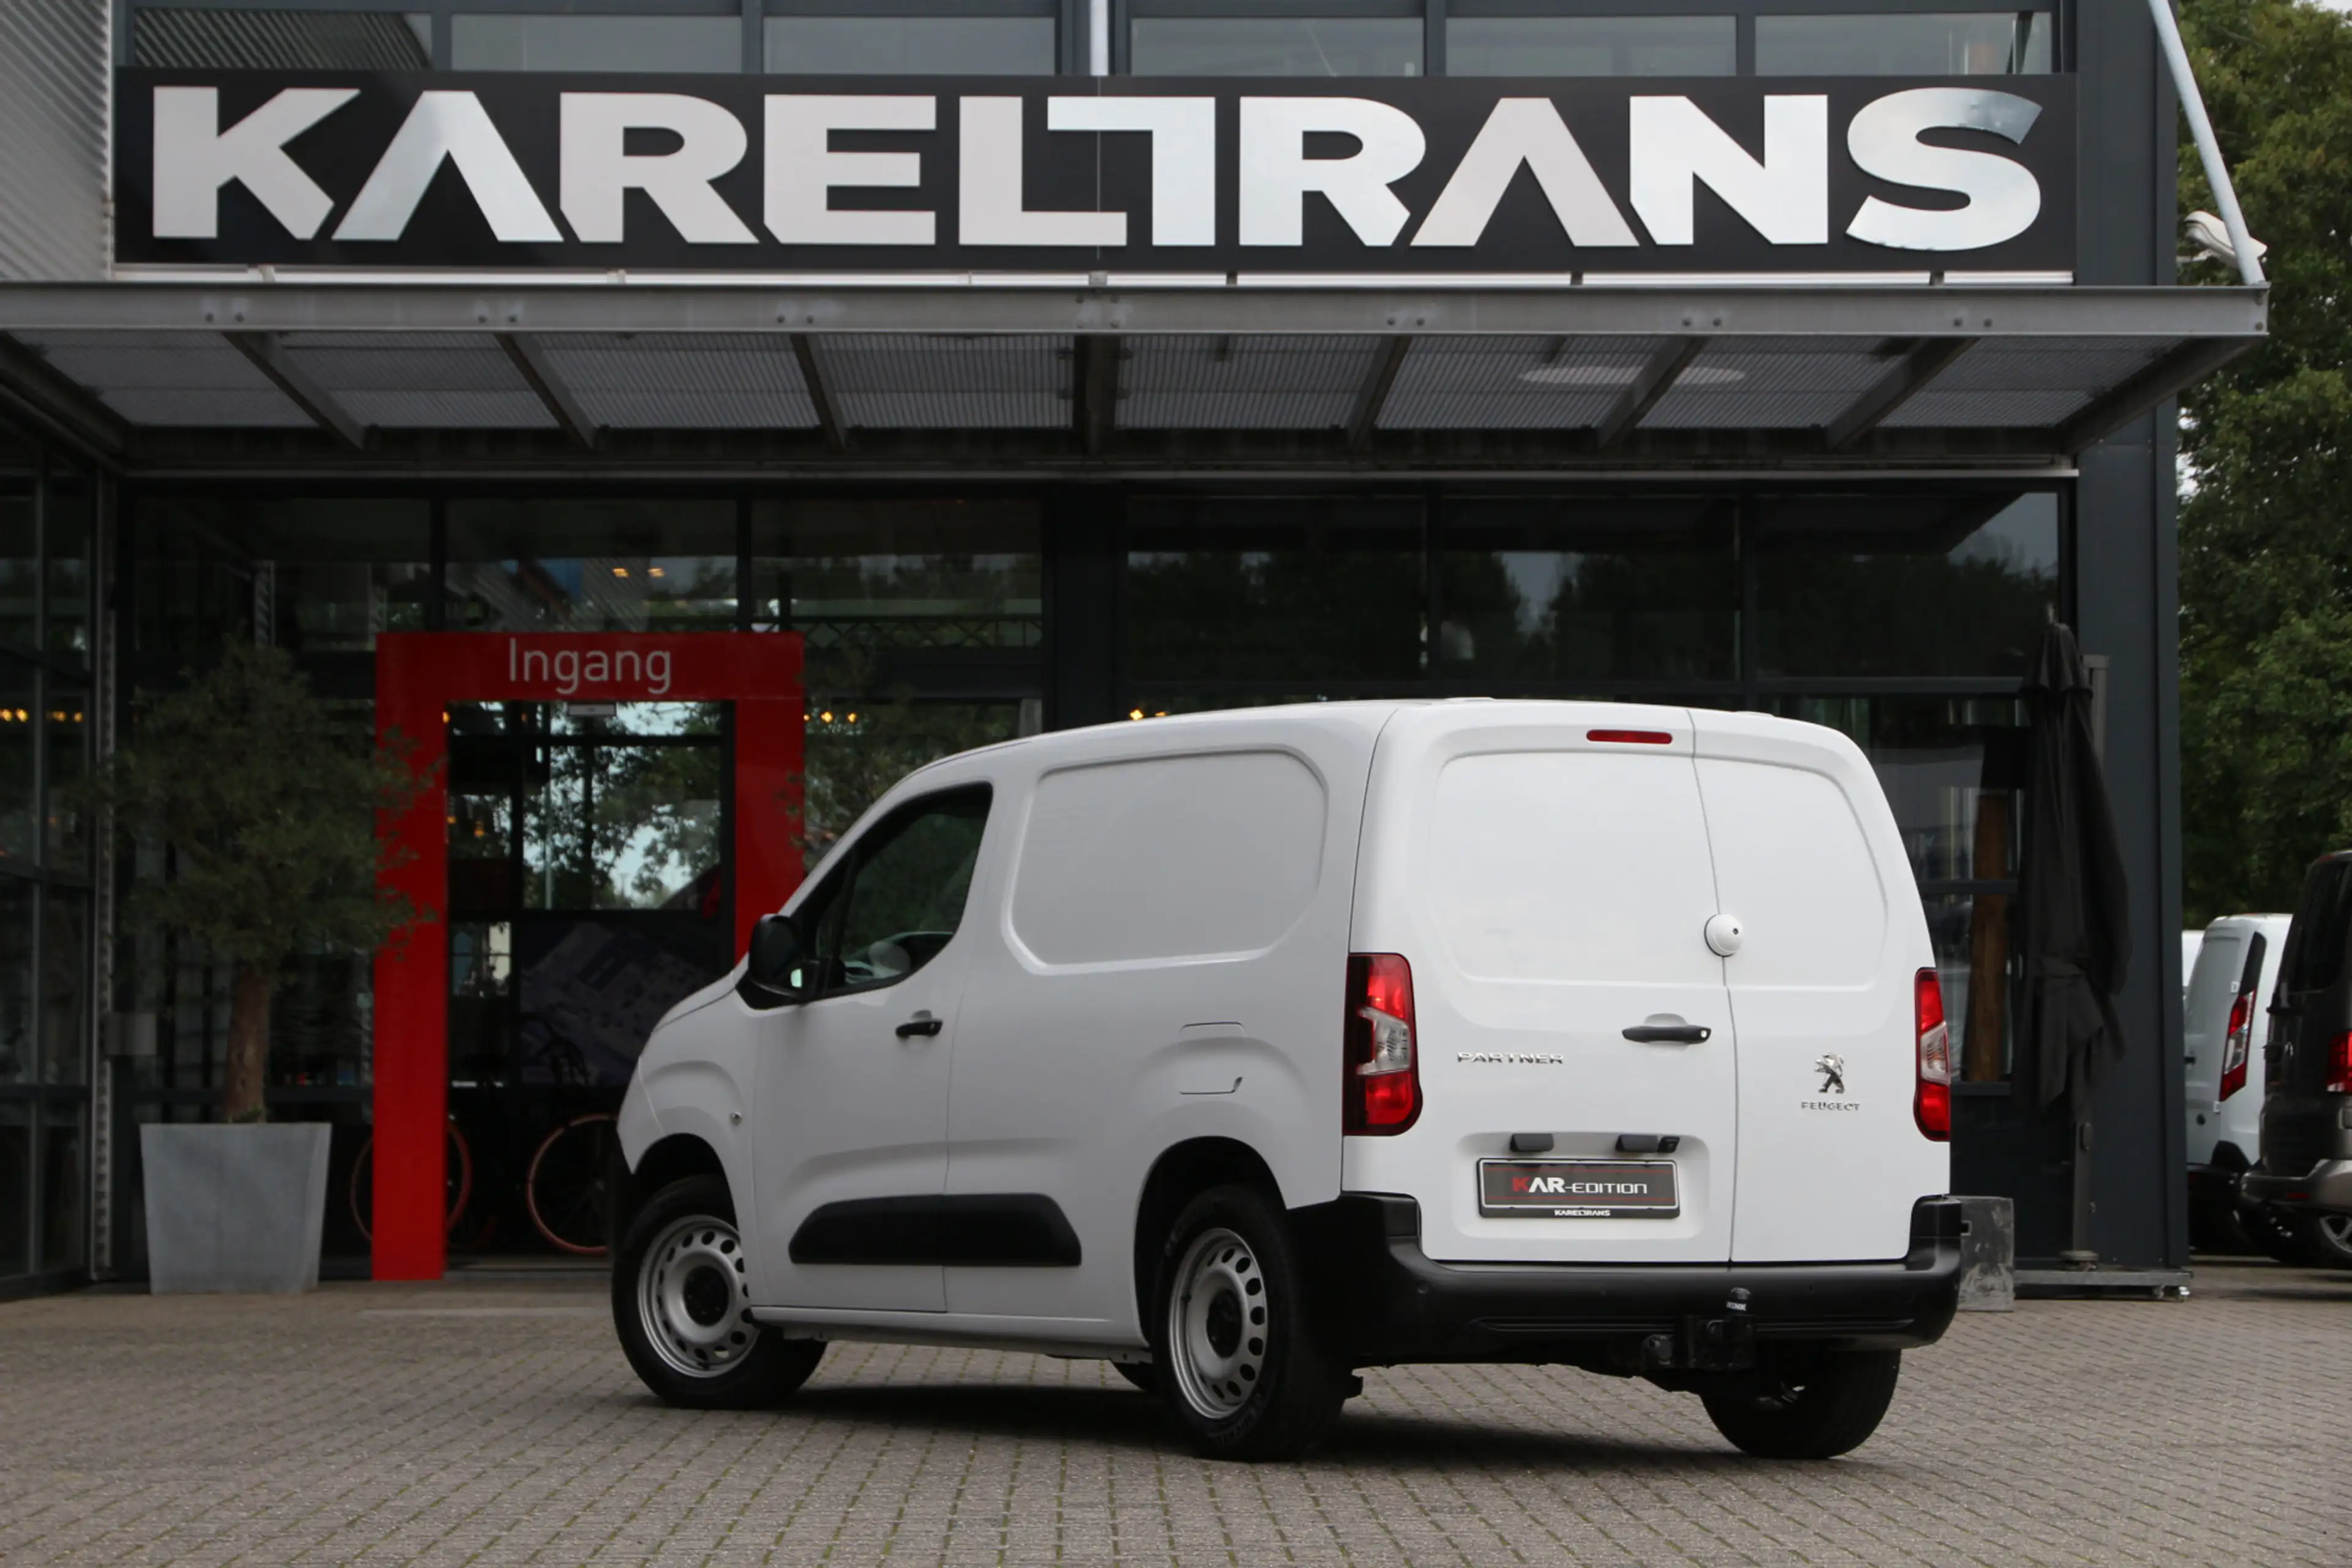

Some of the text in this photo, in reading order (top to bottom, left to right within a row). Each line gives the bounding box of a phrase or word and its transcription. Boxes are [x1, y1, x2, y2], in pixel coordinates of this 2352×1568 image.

[153, 86, 2043, 251] KARELTRANS
[509, 637, 671, 695] Ingang
[1457, 1052, 1564, 1065] PARTNER
[1801, 1101, 1861, 1110] PEUGEOT
